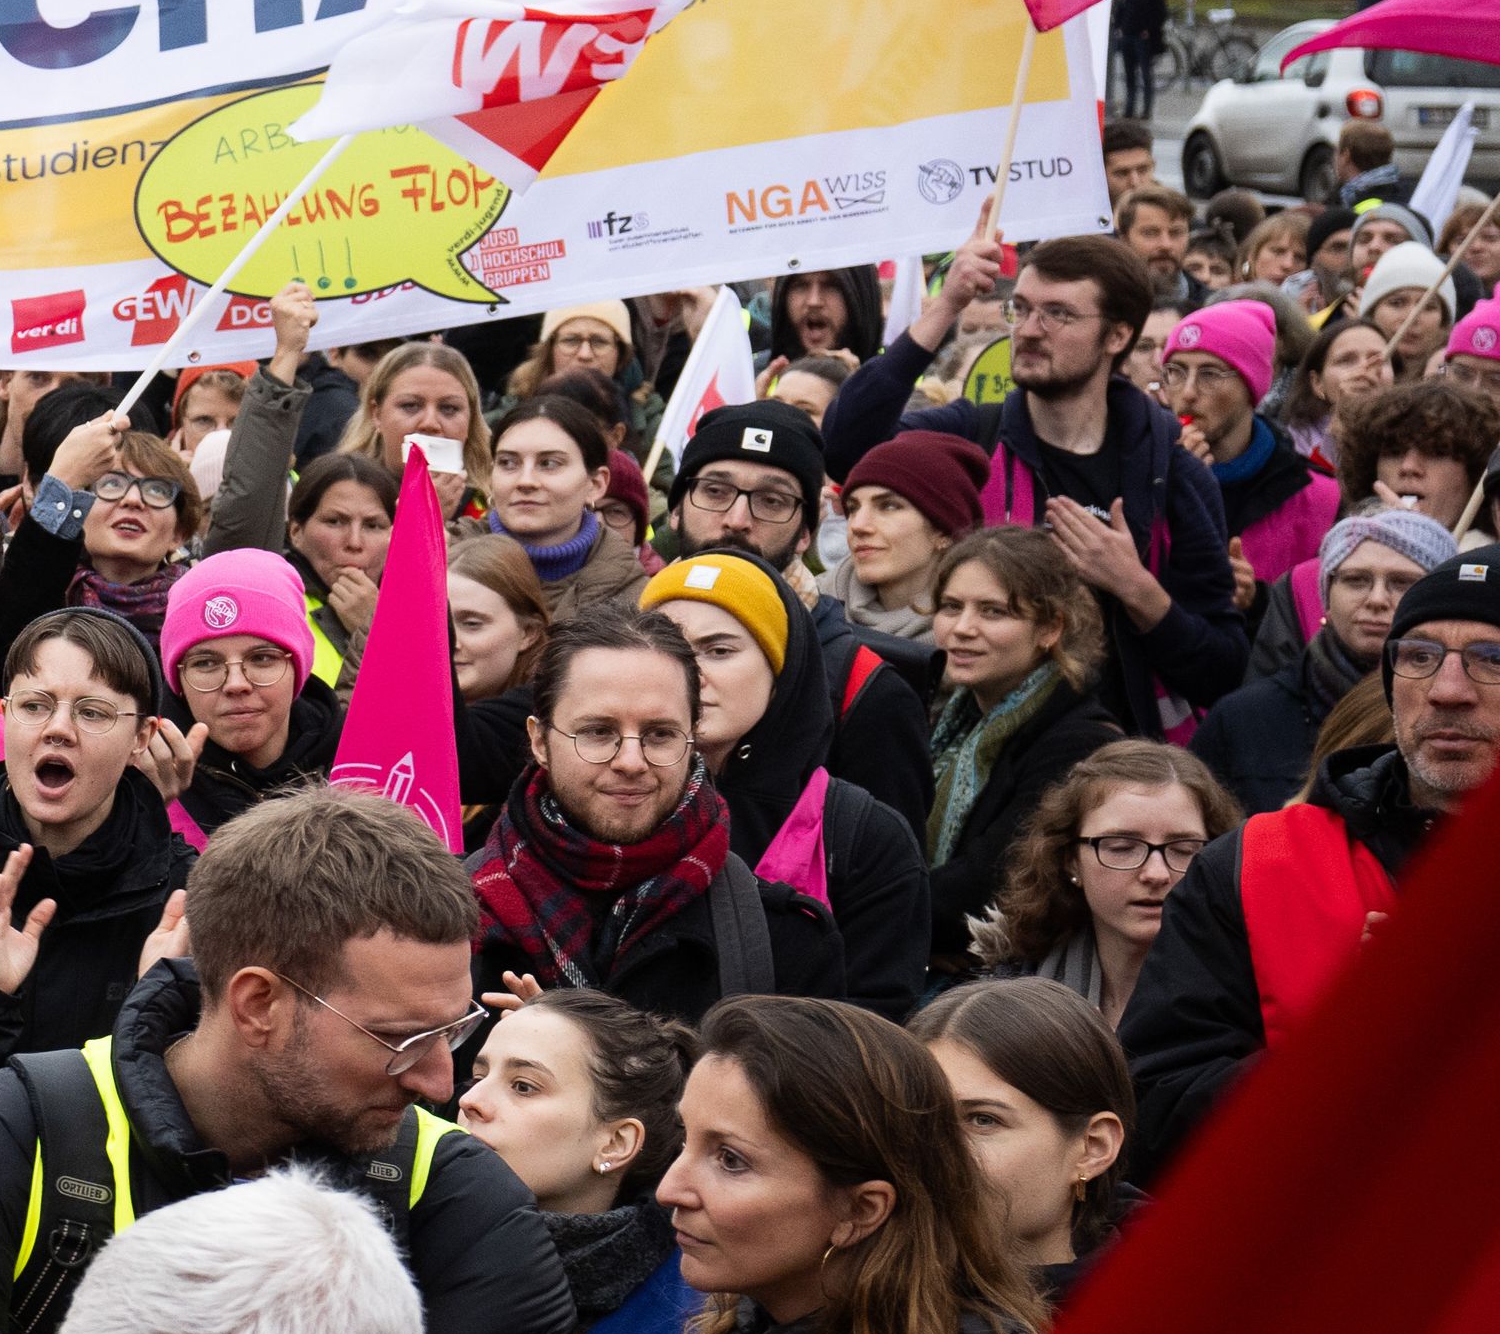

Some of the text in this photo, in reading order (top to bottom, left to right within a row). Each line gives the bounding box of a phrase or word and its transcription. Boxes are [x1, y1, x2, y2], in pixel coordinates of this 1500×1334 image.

[157, 161, 498, 244] BEZAHLUNG FLOP
[481, 242, 564, 268] HOCHSCHUL
[485, 264, 549, 287] GRUPPEN
[114, 289, 194, 323] GEW
[230, 302, 272, 325] DG
[16, 316, 78, 341] ver.di
[61, 1180, 104, 1201] ORTLIEB
